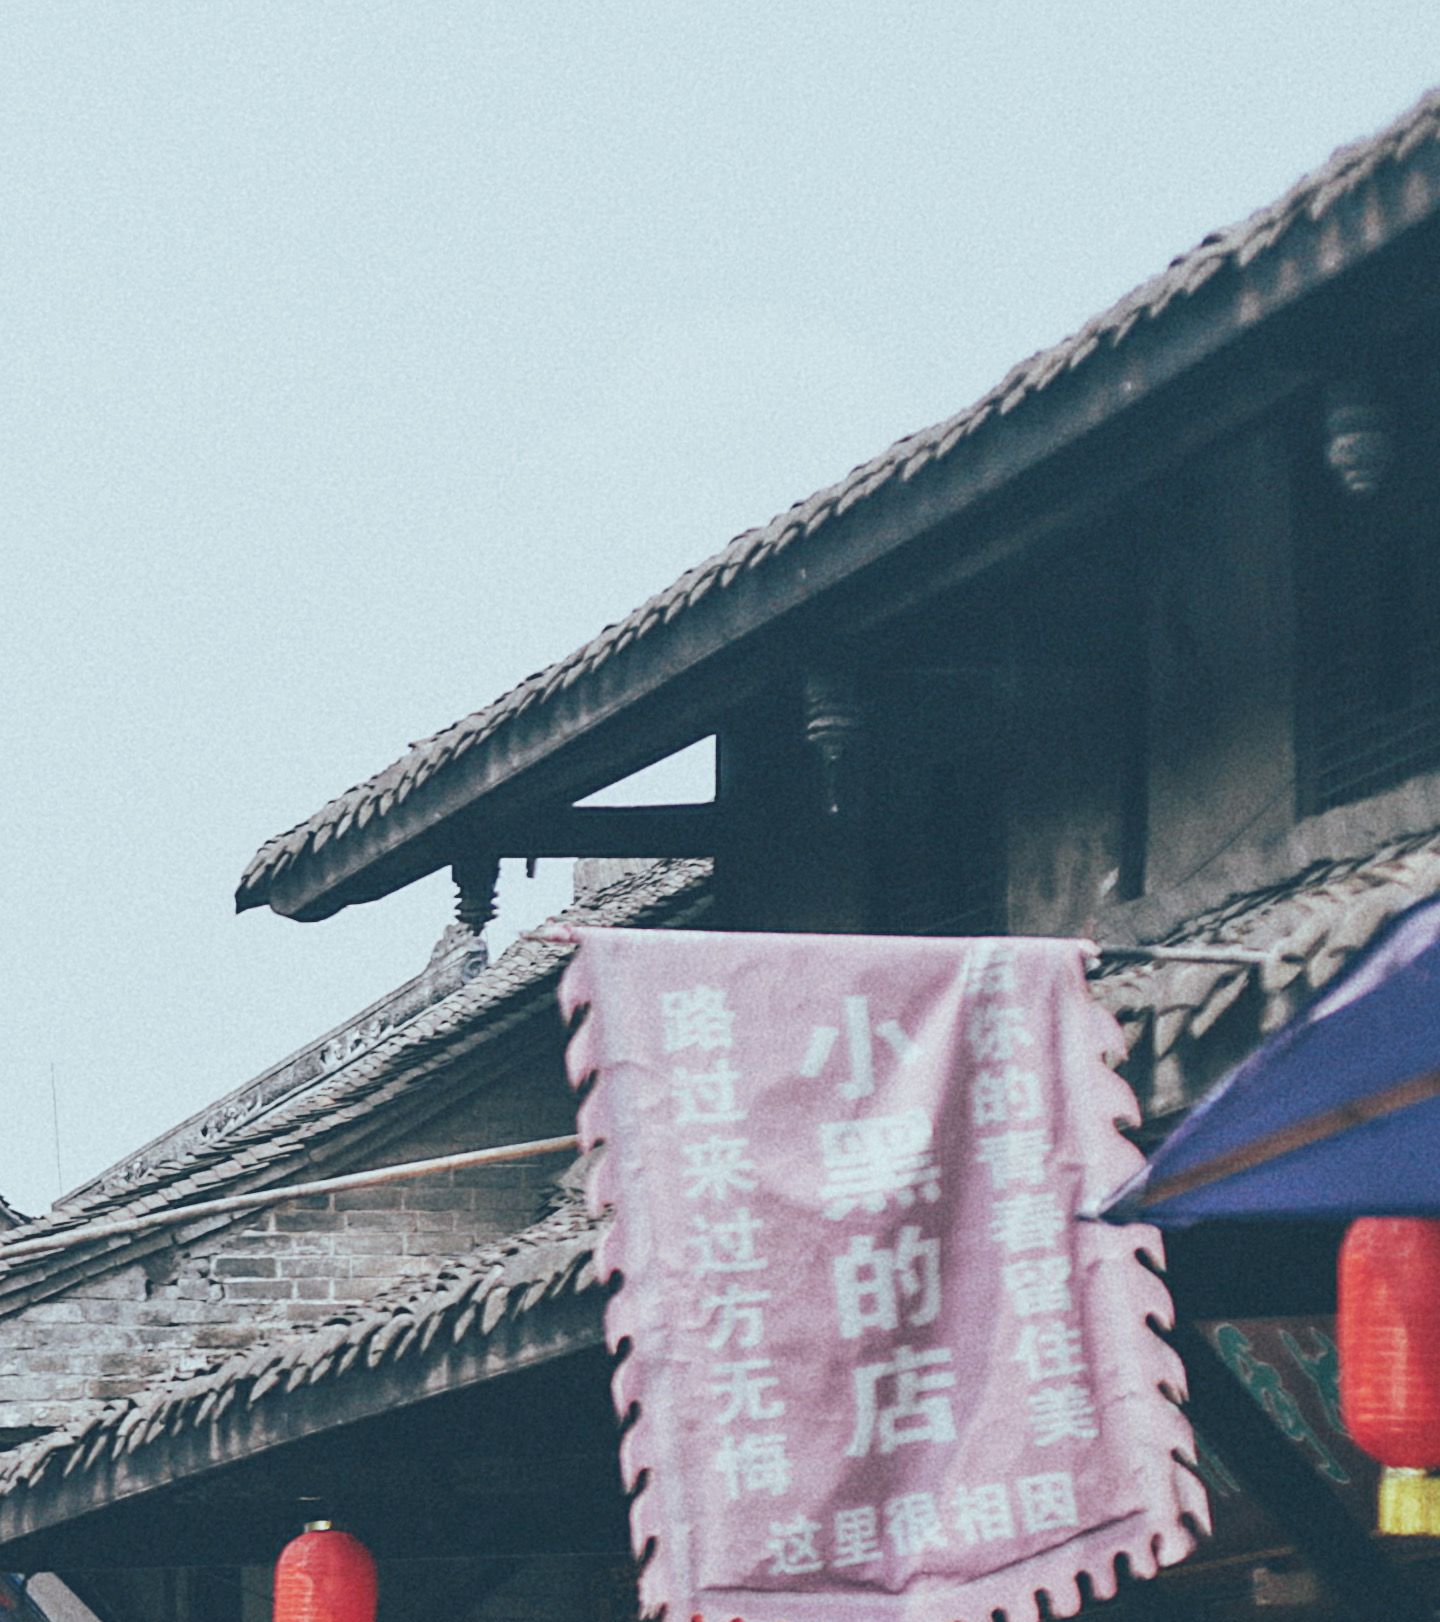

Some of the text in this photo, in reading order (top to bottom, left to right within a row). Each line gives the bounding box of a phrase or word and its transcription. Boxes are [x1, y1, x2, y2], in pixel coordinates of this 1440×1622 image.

[658, 986, 792, 1501] 路过来过方无悔
[797, 994, 958, 1459] 小黑的店
[766, 1472, 1079, 1577] 这里很相因
